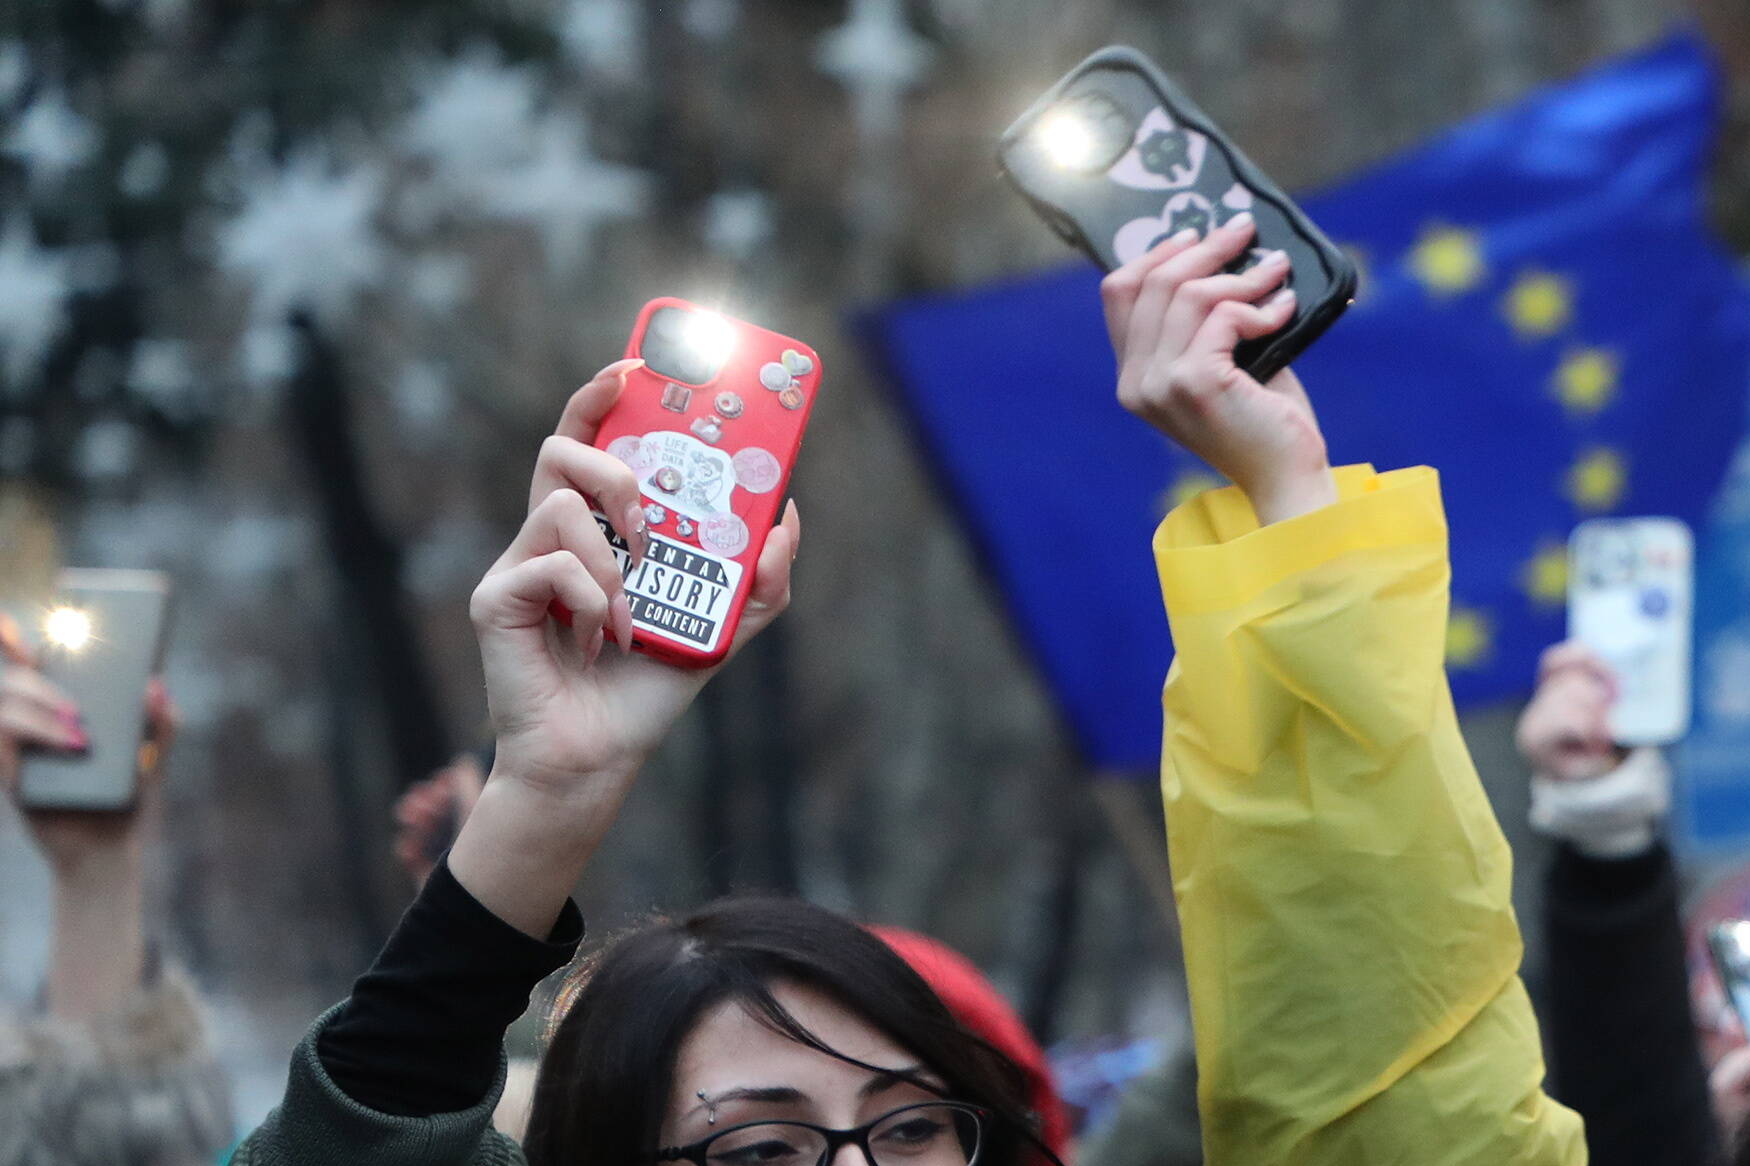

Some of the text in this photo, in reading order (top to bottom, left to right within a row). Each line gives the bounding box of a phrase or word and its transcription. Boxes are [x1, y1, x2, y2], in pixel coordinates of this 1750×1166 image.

[664, 436, 689, 451] LIFE
[661, 453, 684, 467] DATA
[613, 549, 722, 615] VISORY
[644, 603, 708, 638] CONTENT
